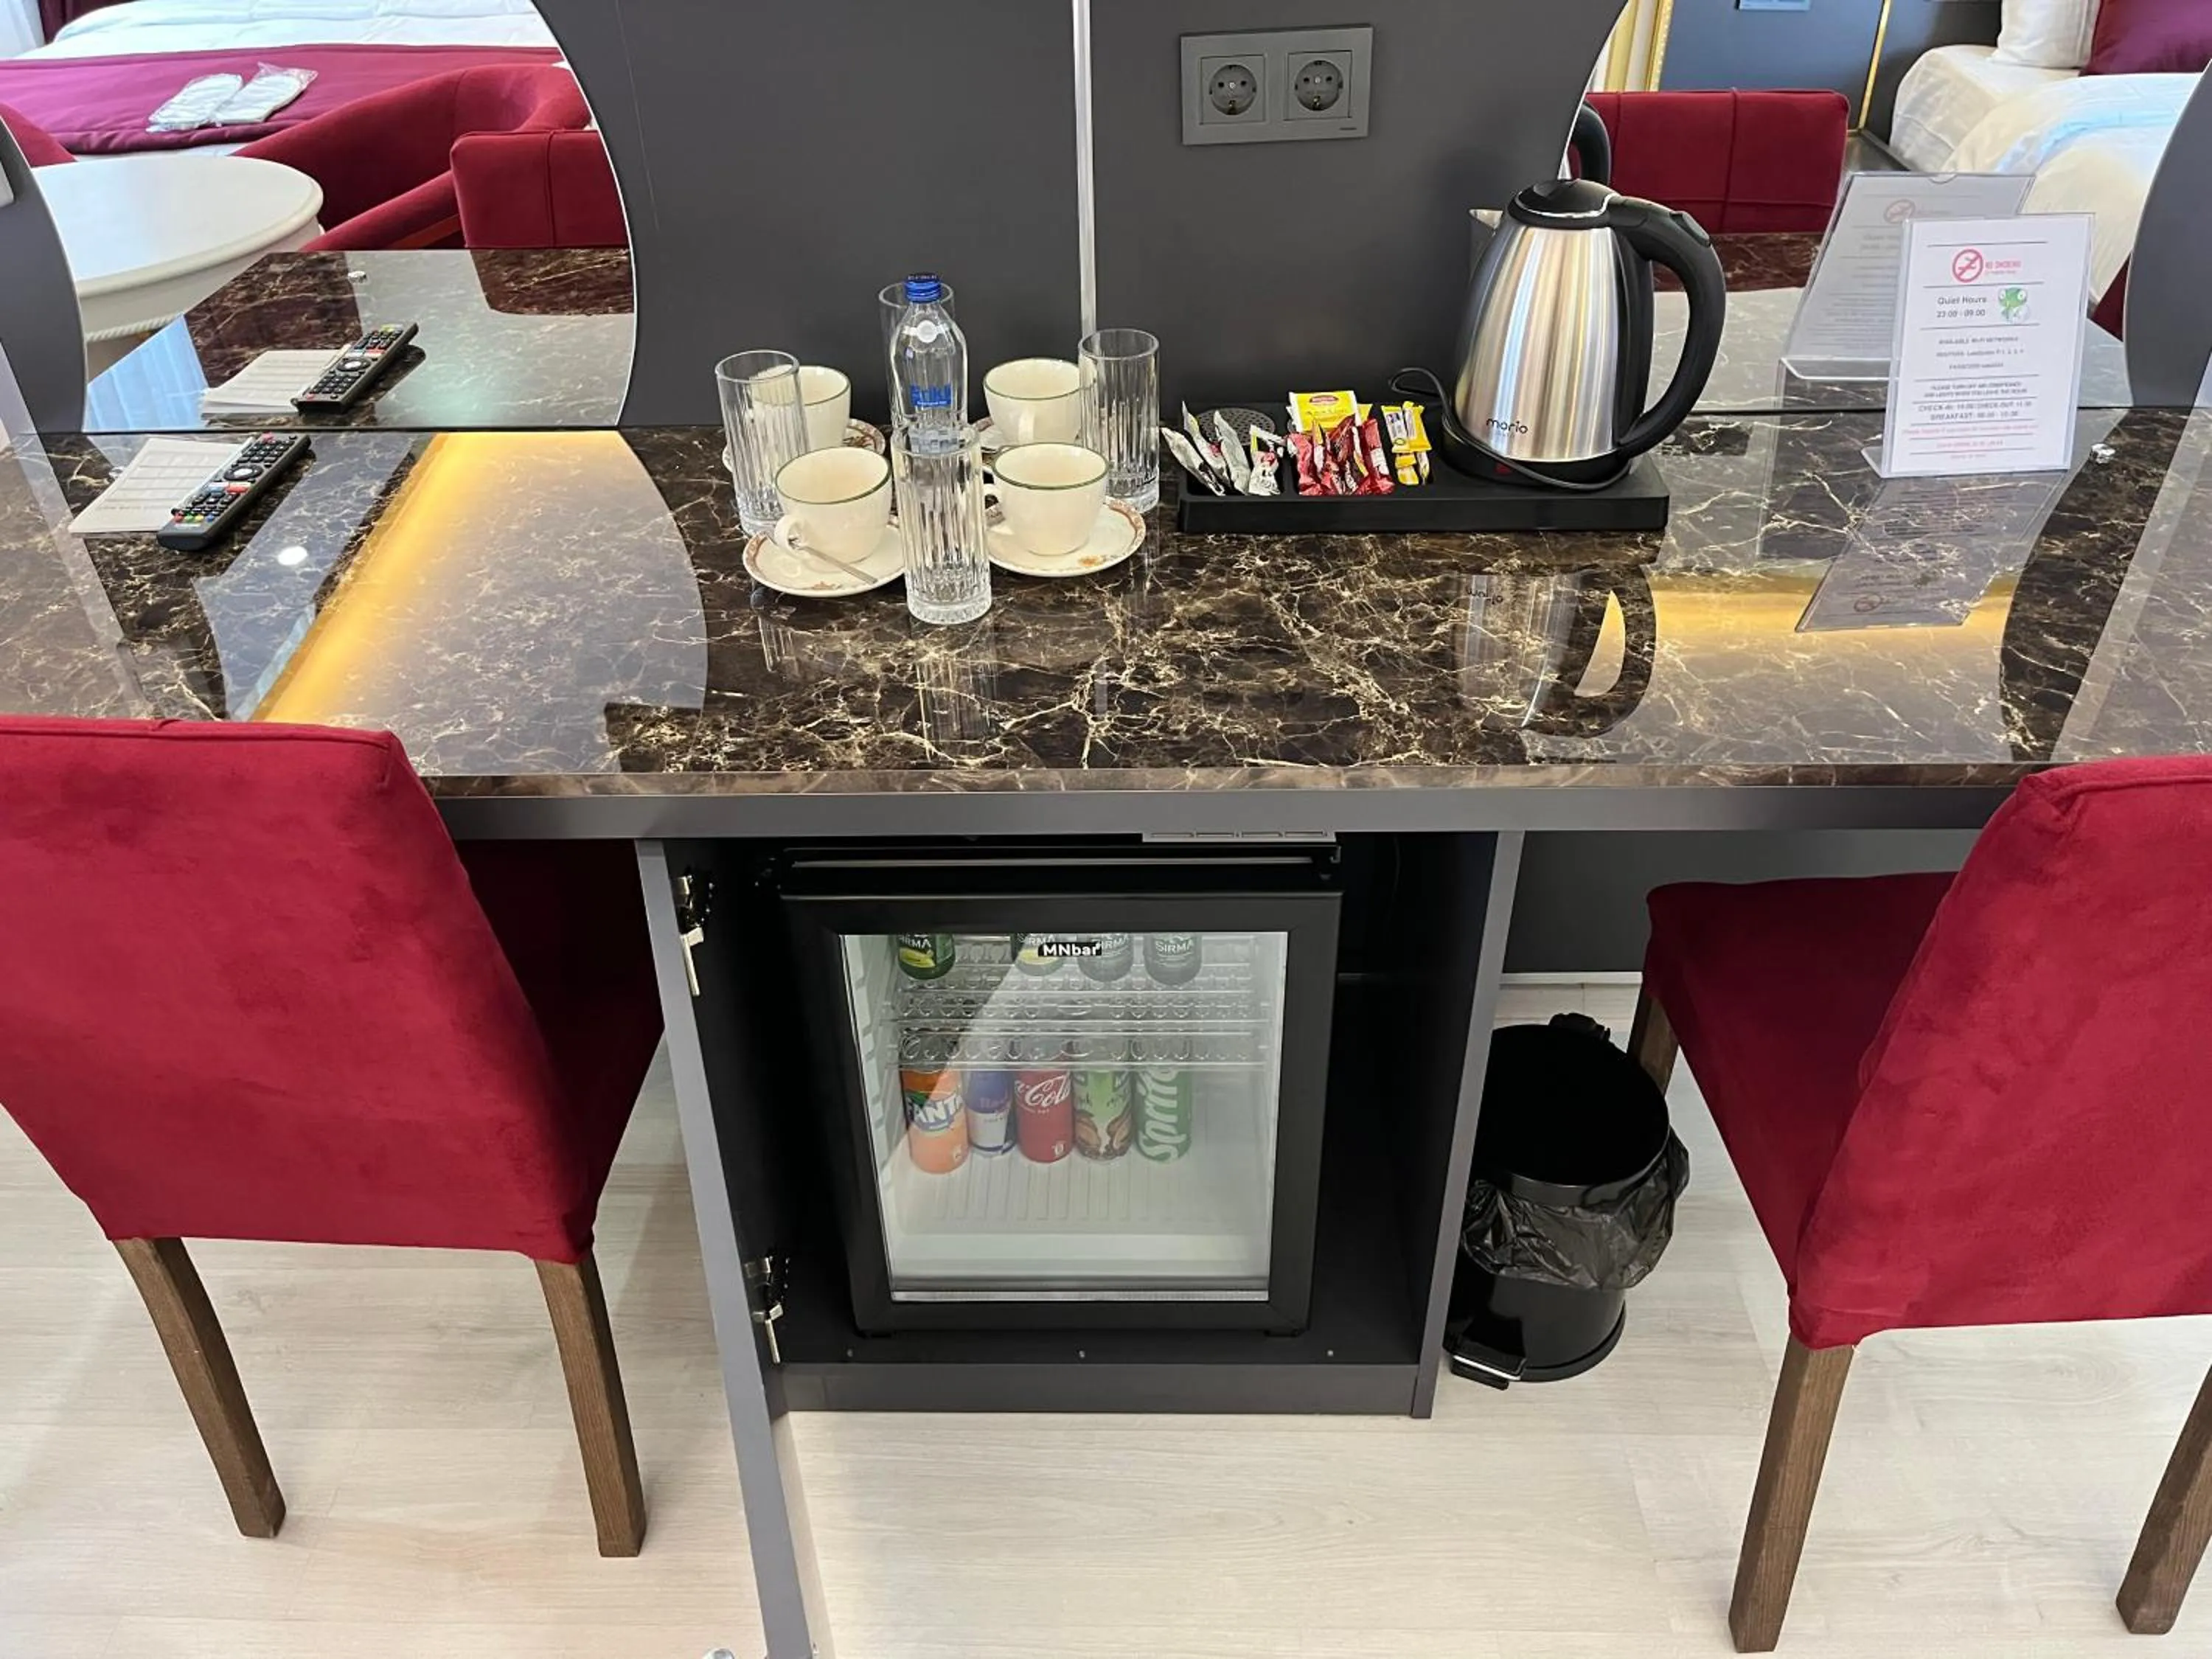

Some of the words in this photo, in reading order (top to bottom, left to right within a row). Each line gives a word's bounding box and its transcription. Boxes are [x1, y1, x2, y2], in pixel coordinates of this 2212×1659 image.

[1937, 297, 1960, 305] Quiet
[1962, 296, 1986, 304] Hours
[1043, 943, 1097, 956] MNbar
[1155, 938, 1194, 953] SIRMA
[906, 1093, 964, 1123] ANT
